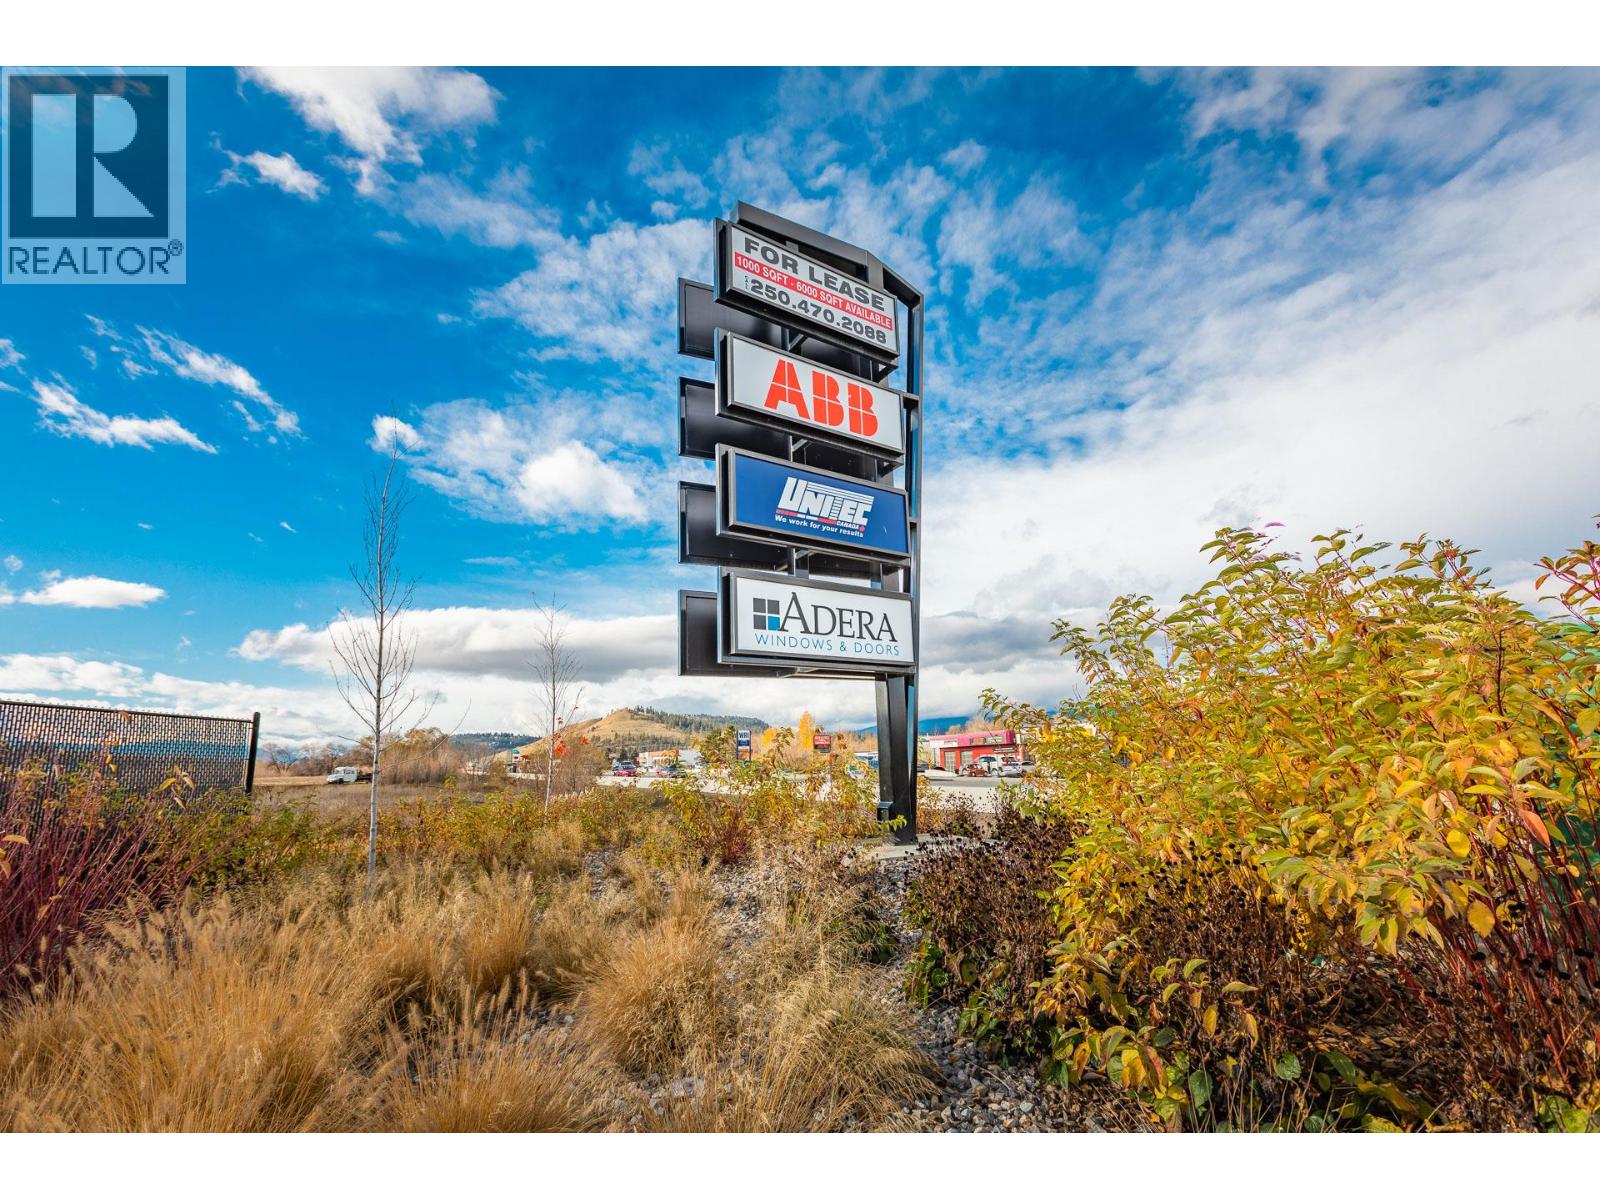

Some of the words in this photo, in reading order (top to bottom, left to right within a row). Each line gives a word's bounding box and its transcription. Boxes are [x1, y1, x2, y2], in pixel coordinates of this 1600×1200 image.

[737, 256, 760, 273] 1000
[762, 266, 789, 286] SQFT
[796, 282, 818, 298] 6000
[820, 291, 844, 308] SQFT
[845, 302, 891, 327] AVAILABLE
[745, 237, 798, 275] FOR
[808, 265, 885, 312] LEASE
[751, 278, 887, 344] 250.470.2088
[763, 359, 879, 437] ABB
[775, 514, 787, 523] We
[788, 518, 808, 527] work
[809, 521, 820, 529] for
[821, 525, 838, 533] your
[839, 529, 864, 538] results
[777, 476, 875, 526] UNITEC
[754, 632, 833, 651] WINDOWS
[839, 641, 848, 651] &
[854, 642, 900, 656] DOORS
[780, 591, 898, 643] ADERA
